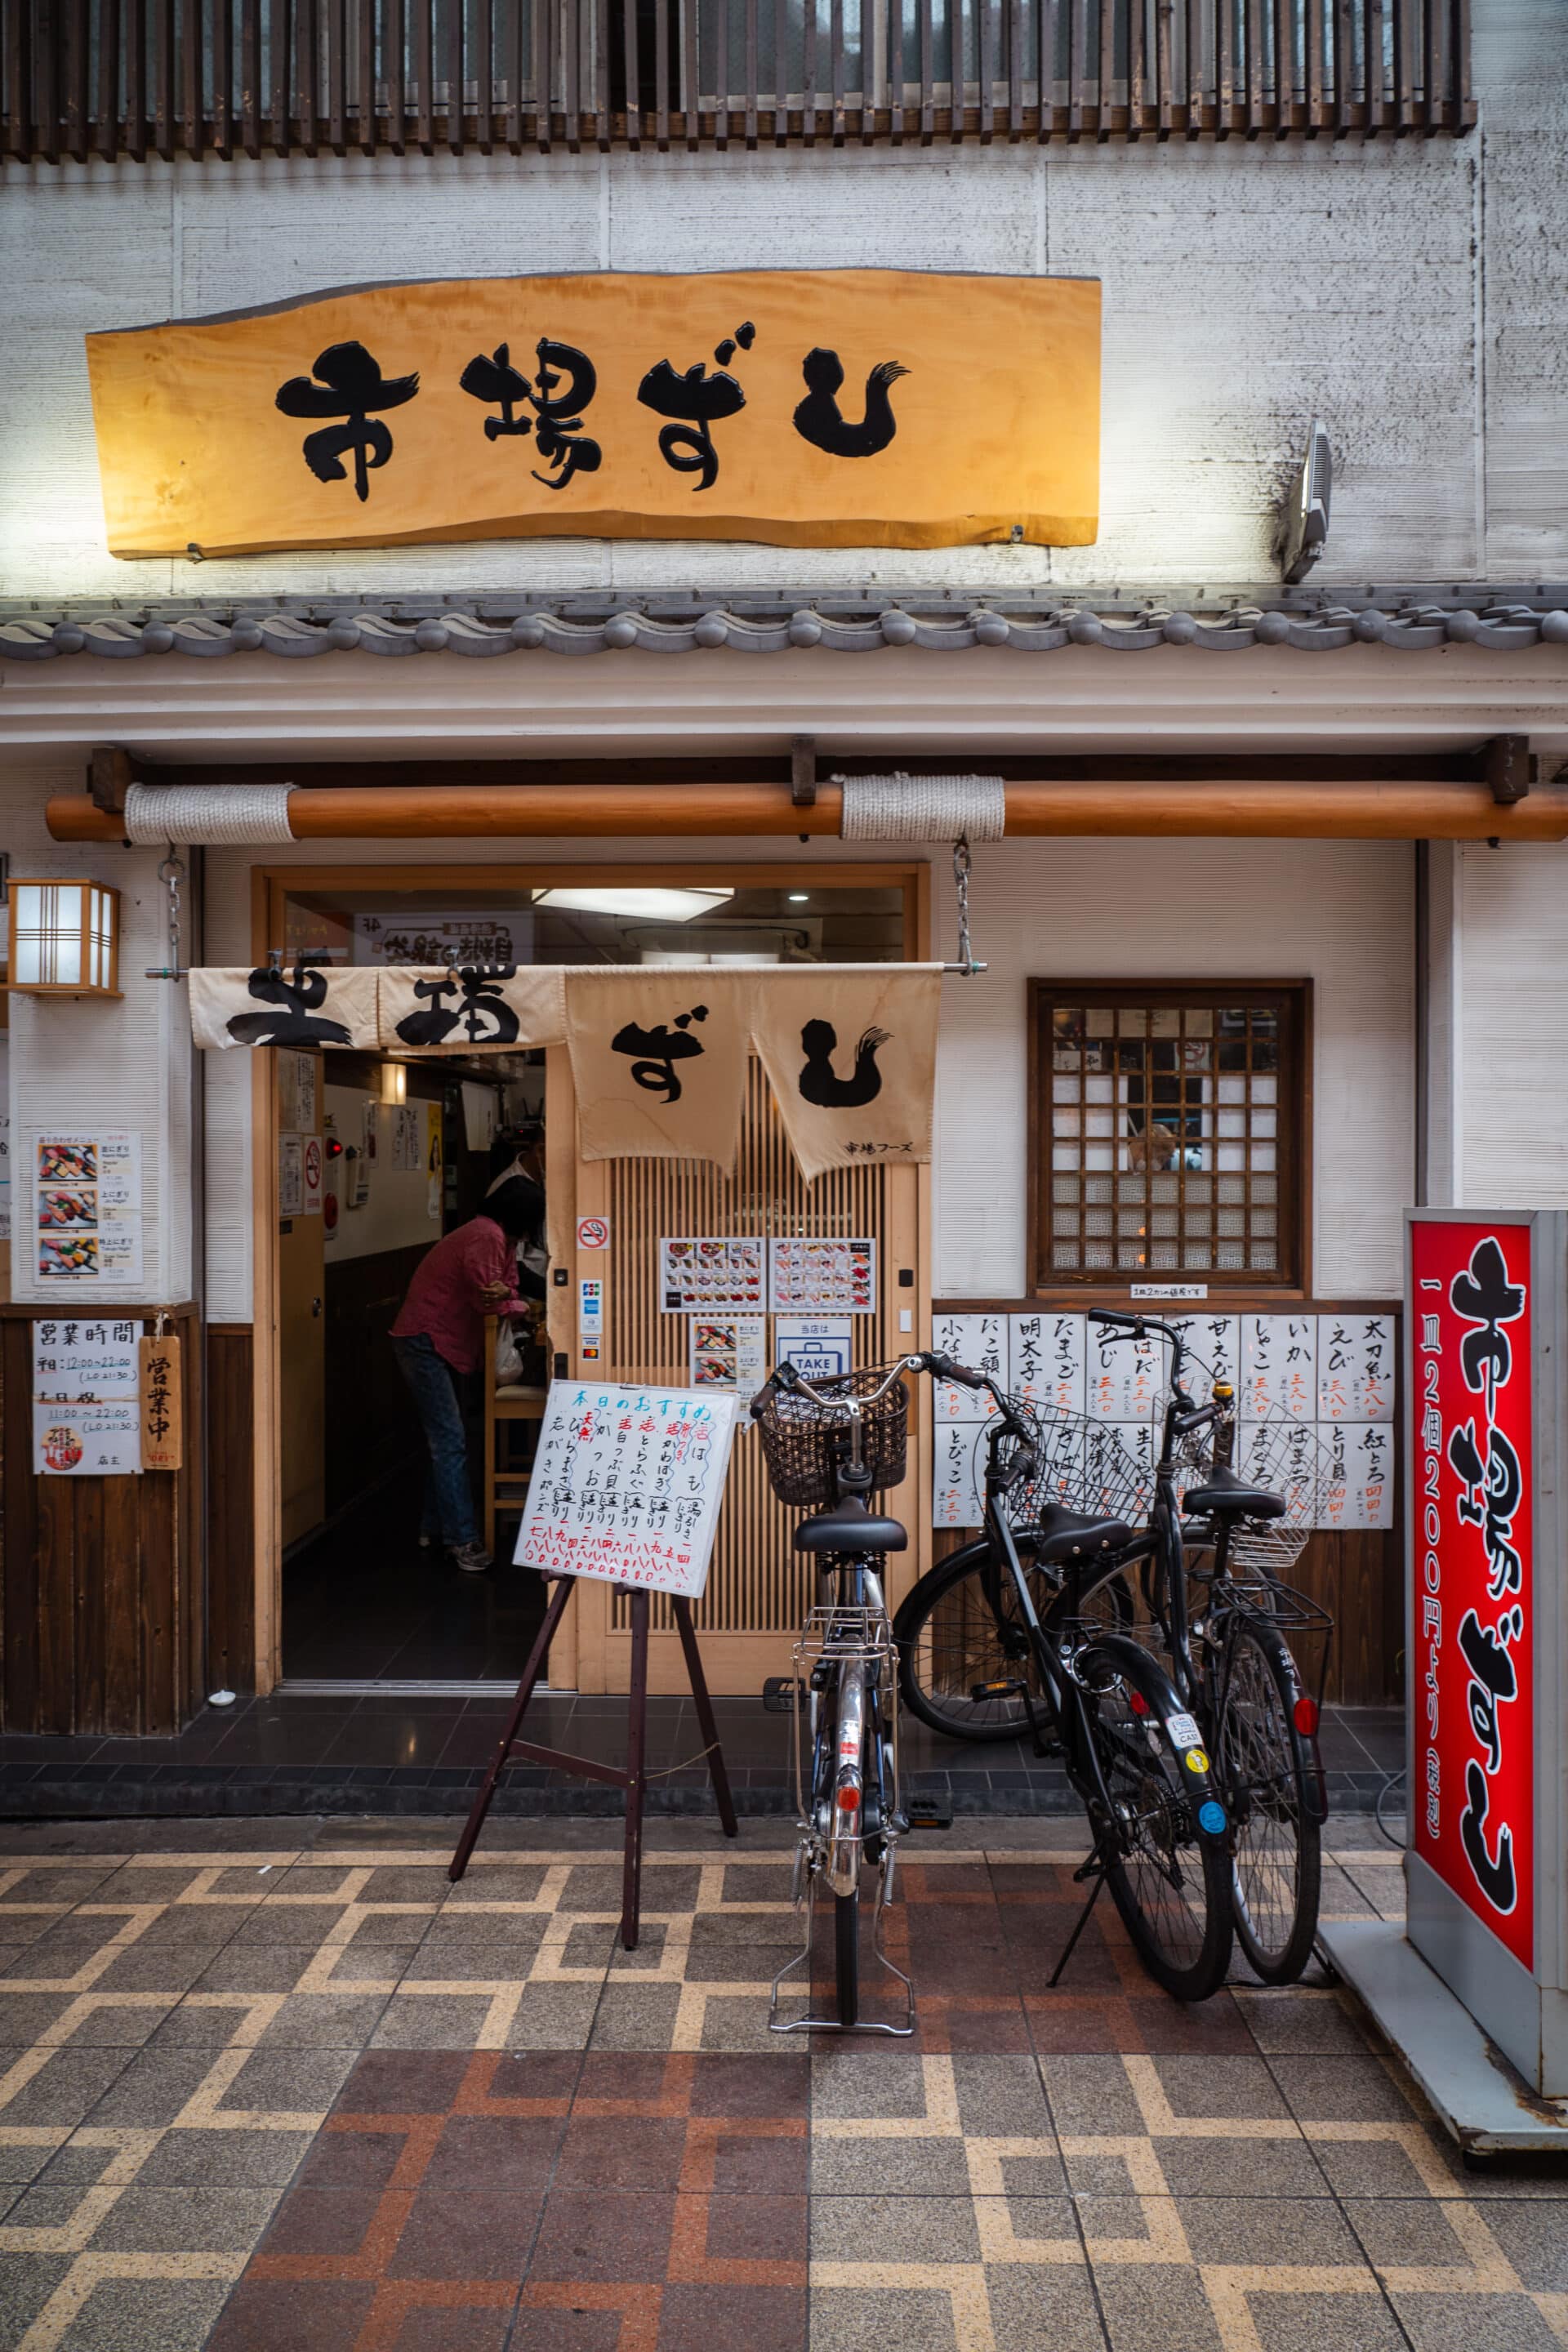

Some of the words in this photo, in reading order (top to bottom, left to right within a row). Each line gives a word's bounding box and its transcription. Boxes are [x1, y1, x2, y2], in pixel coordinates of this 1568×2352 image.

[275, 321, 912, 502] 市場ずし
[40, 1321, 135, 1346] 営業時間
[1019, 1316, 1043, 1381] 明太子
[1054, 1318, 1079, 1379] たまご
[1208, 1318, 1233, 1379] 甘えび
[1254, 1318, 1271, 1370] しゃこ
[1287, 1323, 1312, 1362] いか
[1329, 1322, 1354, 1370] えび
[1361, 1320, 1392, 1380] 太刀魚
[797, 1359, 830, 1369] TAKE
[147, 1357, 172, 1442] 営業中
[572, 1390, 711, 1421] 本日のおすすめ
[97, 1454, 120, 1465] 店主
[948, 1428, 967, 1484] とびっこ
[1358, 1428, 1387, 1483] 紅とろ
[1447, 1236, 1526, 1916] 市場ずし
